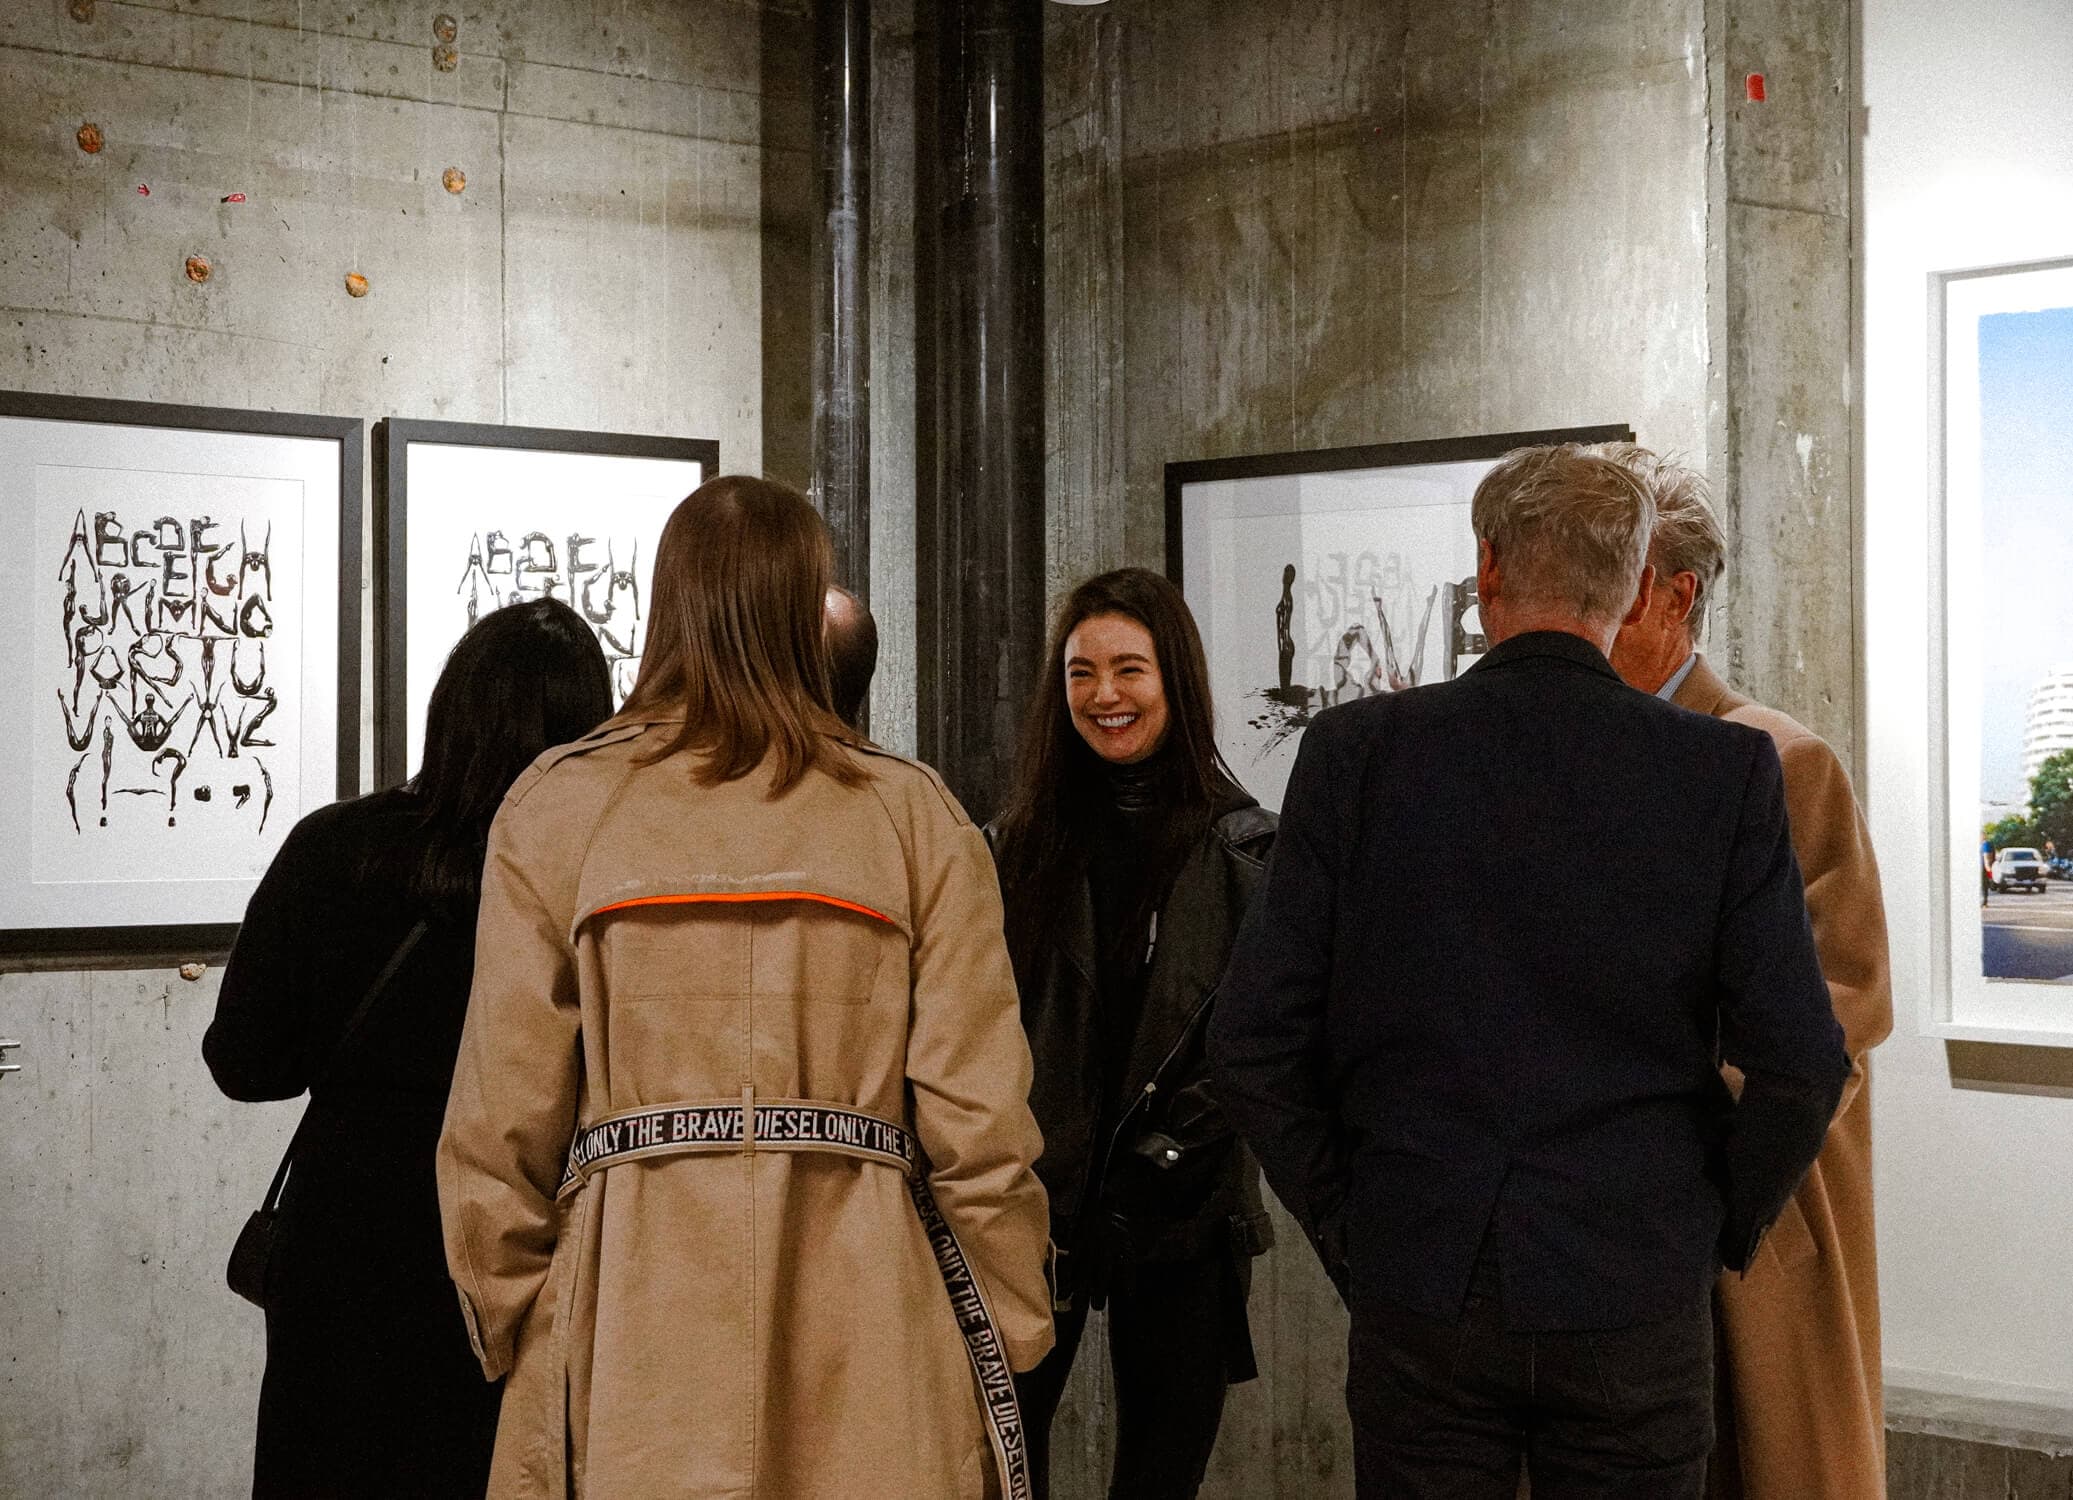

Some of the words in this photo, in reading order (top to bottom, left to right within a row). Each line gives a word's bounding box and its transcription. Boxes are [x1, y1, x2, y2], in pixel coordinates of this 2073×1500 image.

[586, 1122, 623, 1161] ONLY
[625, 1115, 666, 1149] THE
[672, 1109, 743, 1141] BRAVE
[753, 1109, 822, 1140] DIESEL
[825, 1115, 870, 1147] ONLY
[873, 1122, 902, 1157] THE
[934, 1235, 970, 1284] ONLY
[950, 1284, 986, 1328] THE
[967, 1328, 1013, 1401] BRAVE
[992, 1400, 1024, 1474] DIESEL
